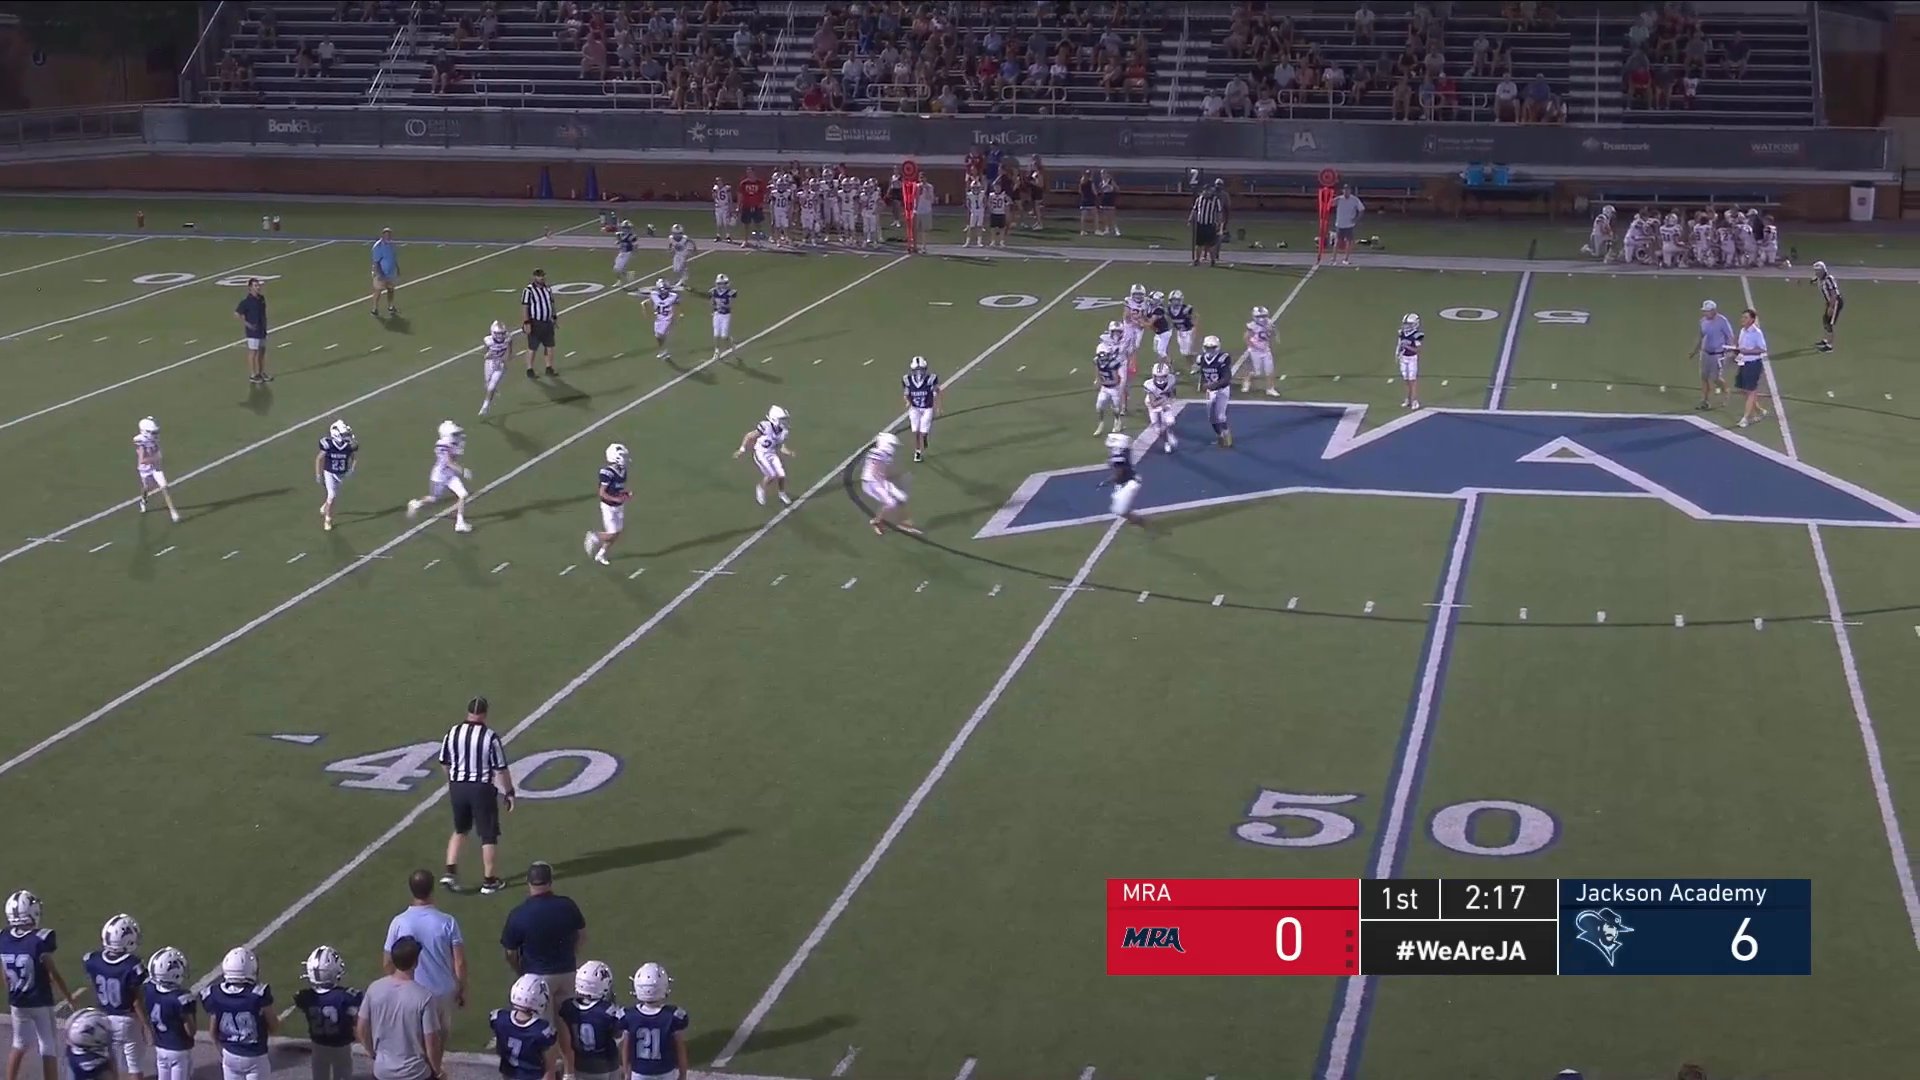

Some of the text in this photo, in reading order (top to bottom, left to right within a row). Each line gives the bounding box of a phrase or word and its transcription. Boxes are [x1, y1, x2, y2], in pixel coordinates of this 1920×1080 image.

[972, 130, 1037, 144] TrustCare
[1190, 168, 1199, 184] 2
[331, 459, 346, 471] 23
[150, 1003, 167, 1033] 4
[507, 1037, 522, 1067] 7
[635, 1027, 661, 1060] 21
